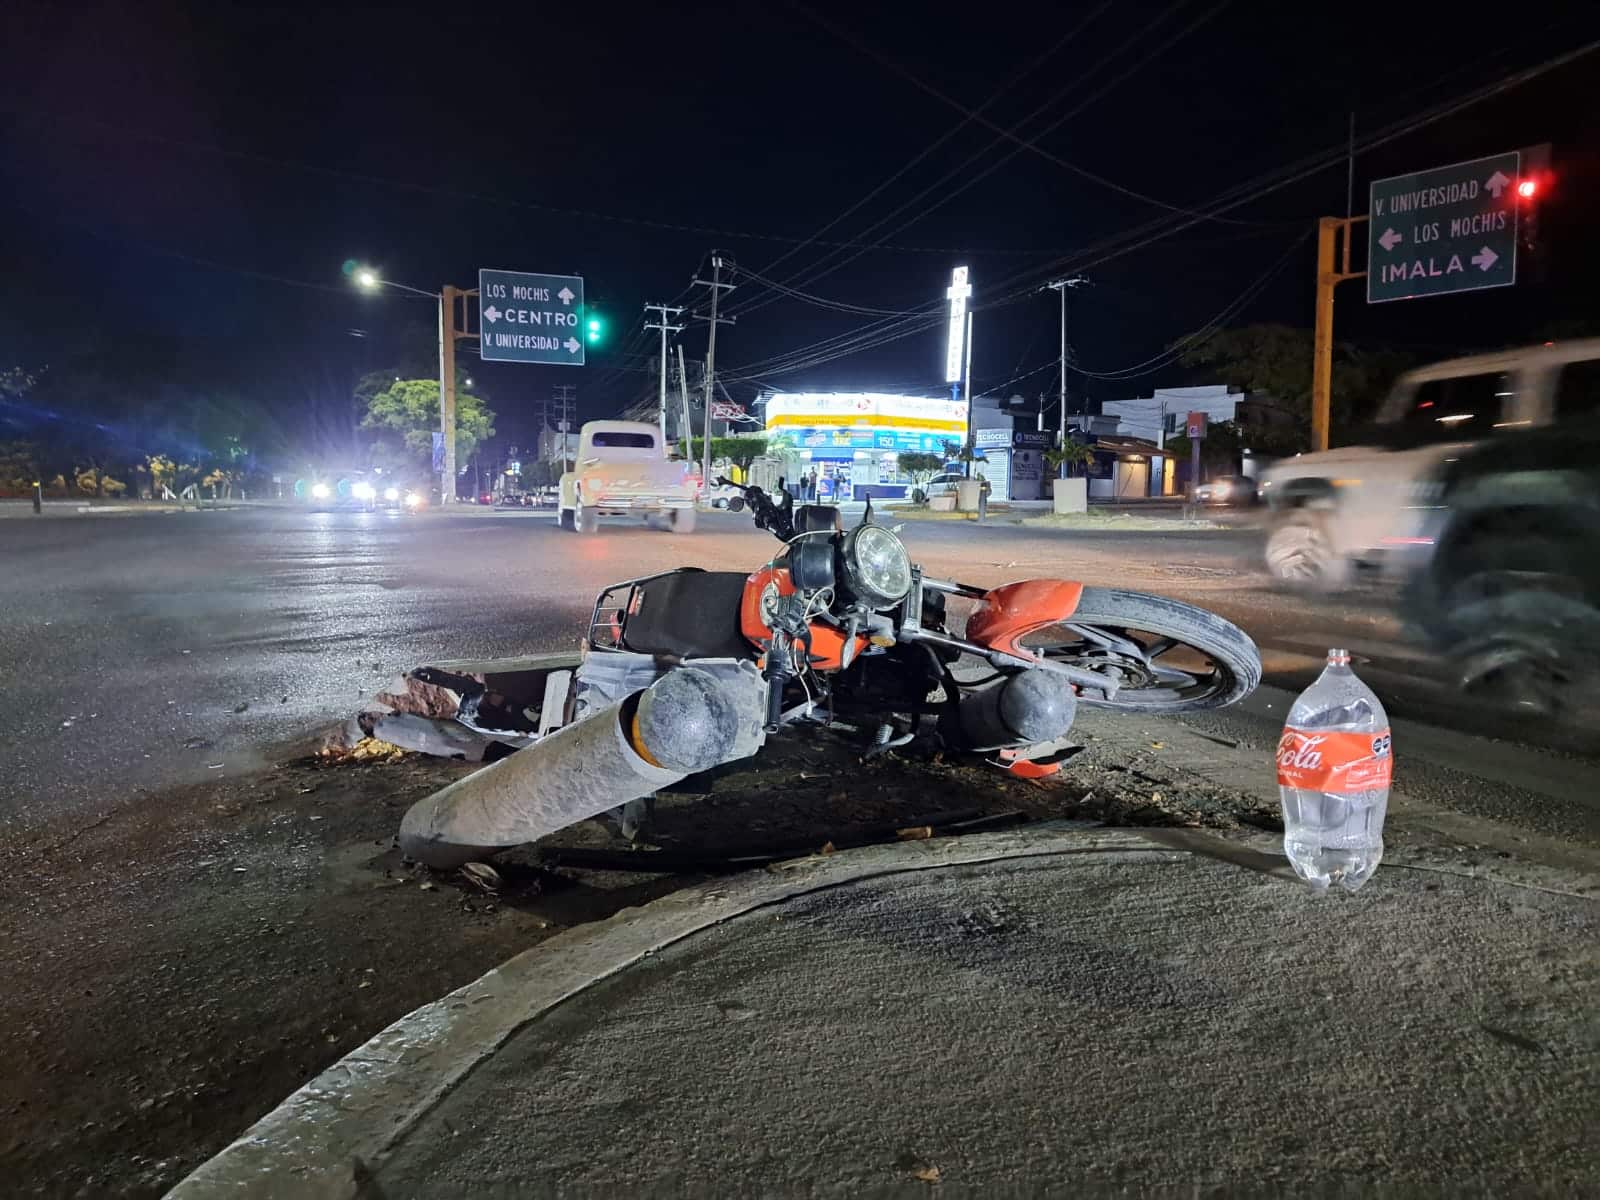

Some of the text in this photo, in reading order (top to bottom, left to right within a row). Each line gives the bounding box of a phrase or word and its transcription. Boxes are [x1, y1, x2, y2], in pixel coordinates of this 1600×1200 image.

[1391, 180, 1478, 214] UNIVERSIDAD
[1414, 211, 1507, 244] LOS MOCHIS
[1382, 254, 1464, 284] IMALA
[487, 284, 549, 301] LOS MOCHIS
[505, 308, 578, 327] CENTRO
[495, 333, 559, 350] UNIVERSIDAD
